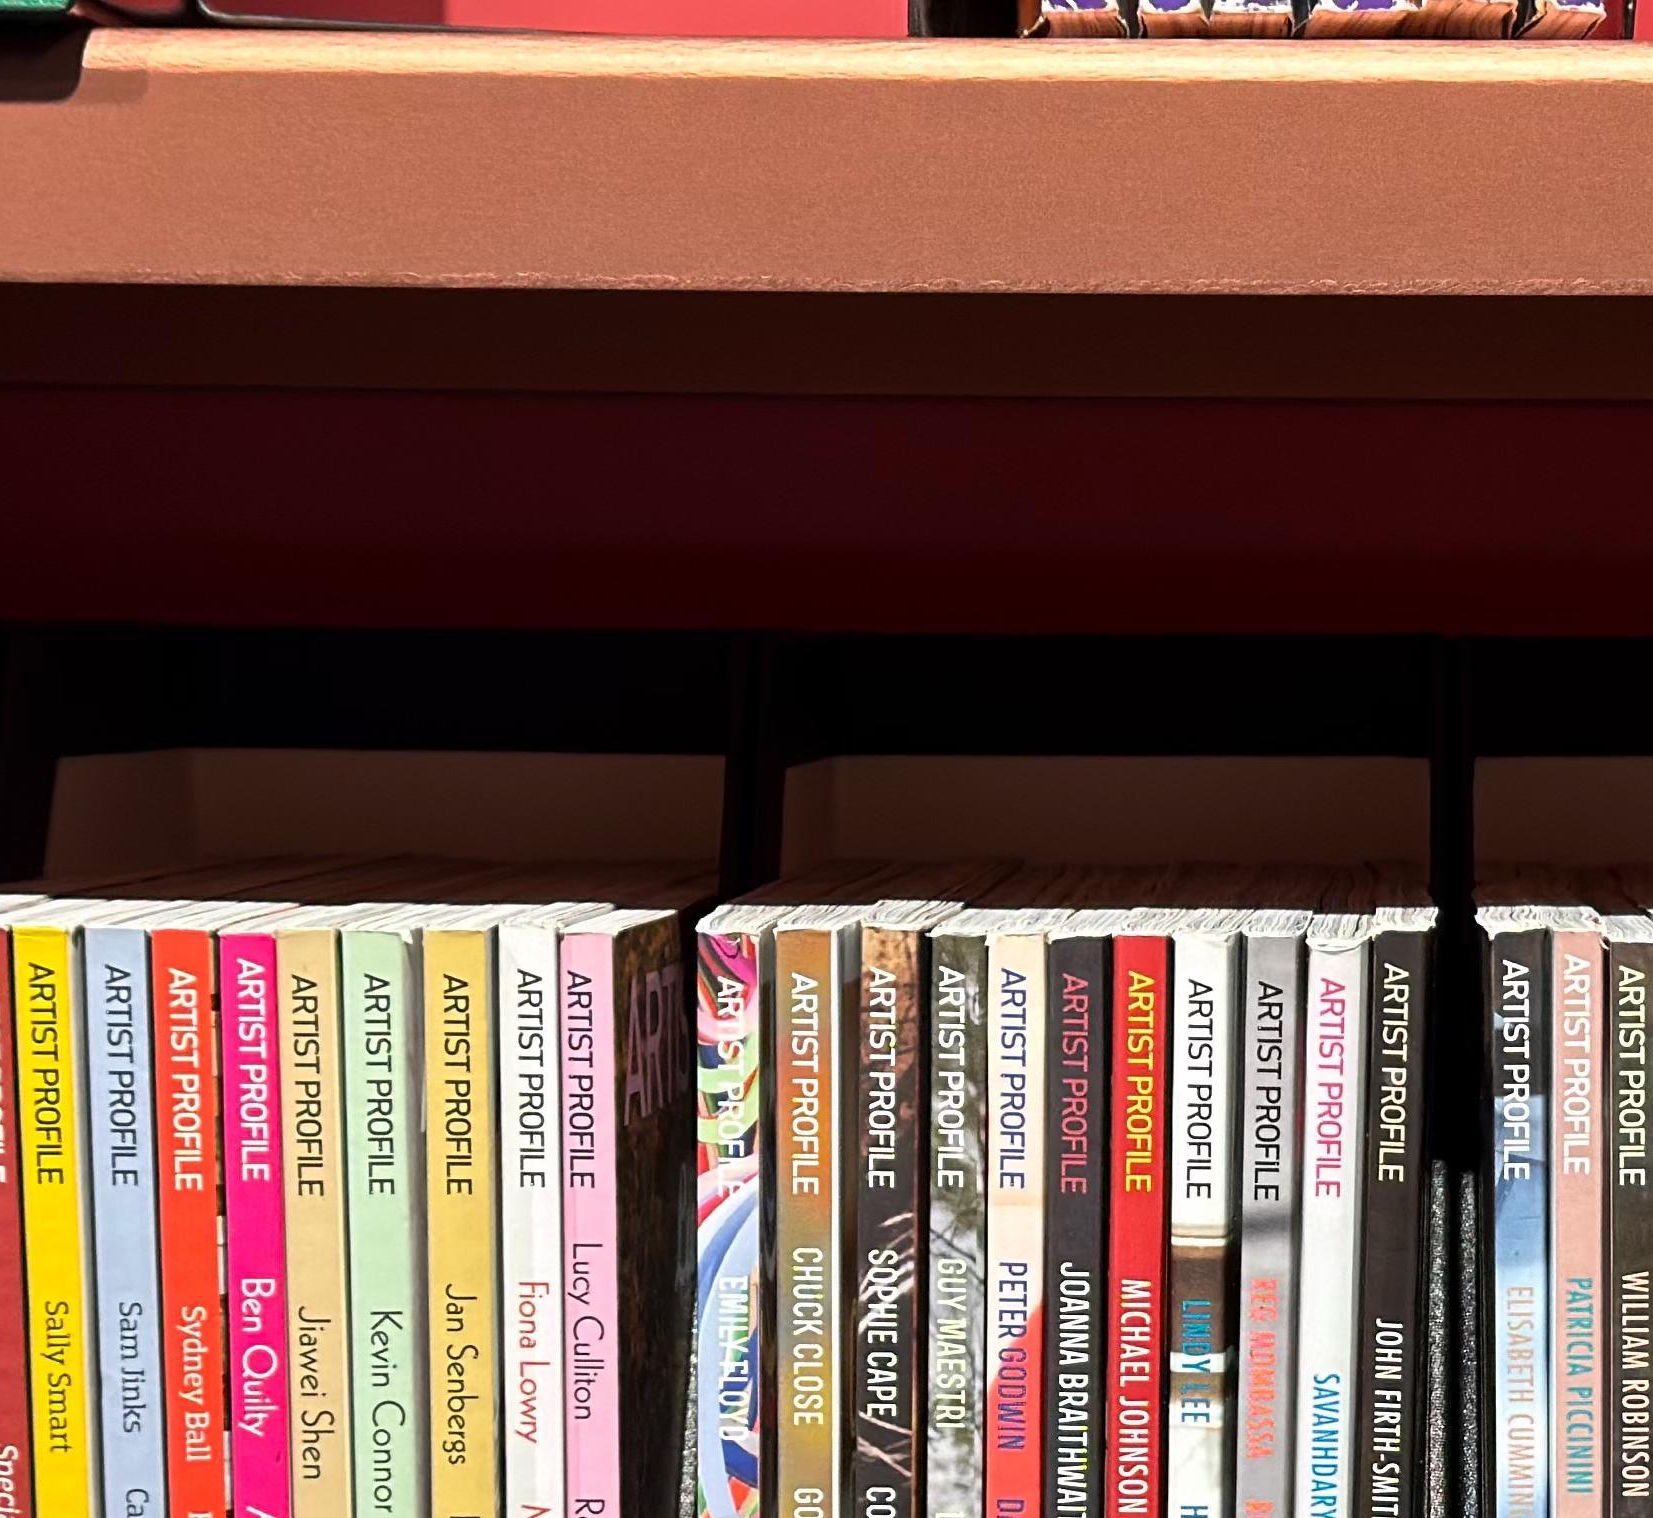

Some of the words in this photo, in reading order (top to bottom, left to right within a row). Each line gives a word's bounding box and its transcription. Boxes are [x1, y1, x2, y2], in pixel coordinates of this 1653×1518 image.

[1128, 971, 1154, 1070] ARTIST
[1382, 963, 1409, 1062] ARTIST
[1126, 1077, 1153, 1191] PROFILE
[1379, 1068, 1406, 1182] PROFILE
[242, 1279, 275, 1331] Ben
[793, 1248, 823, 1335] CHUCK
[1059, 1262, 1090, 1365] JOANNA
[1120, 1280, 1151, 1387] MICHAEL
[1566, 1278, 1594, 1376] PATRICIA
[1622, 1272, 1649, 1369] WILLIAM
[238, 1345, 277, 1436] Quilty
[299, 1306, 331, 1396] Jiawei
[793, 1344, 823, 1425] CLOSE
[1375, 1318, 1403, 1379] JOHN
[301, 1411, 334, 1479] Shen
[1119, 1396, 1149, 1512] JOHNSON
[1566, 1387, 1594, 1493] PICCININI
[1622, 1380, 1649, 1496] ROBINSON
